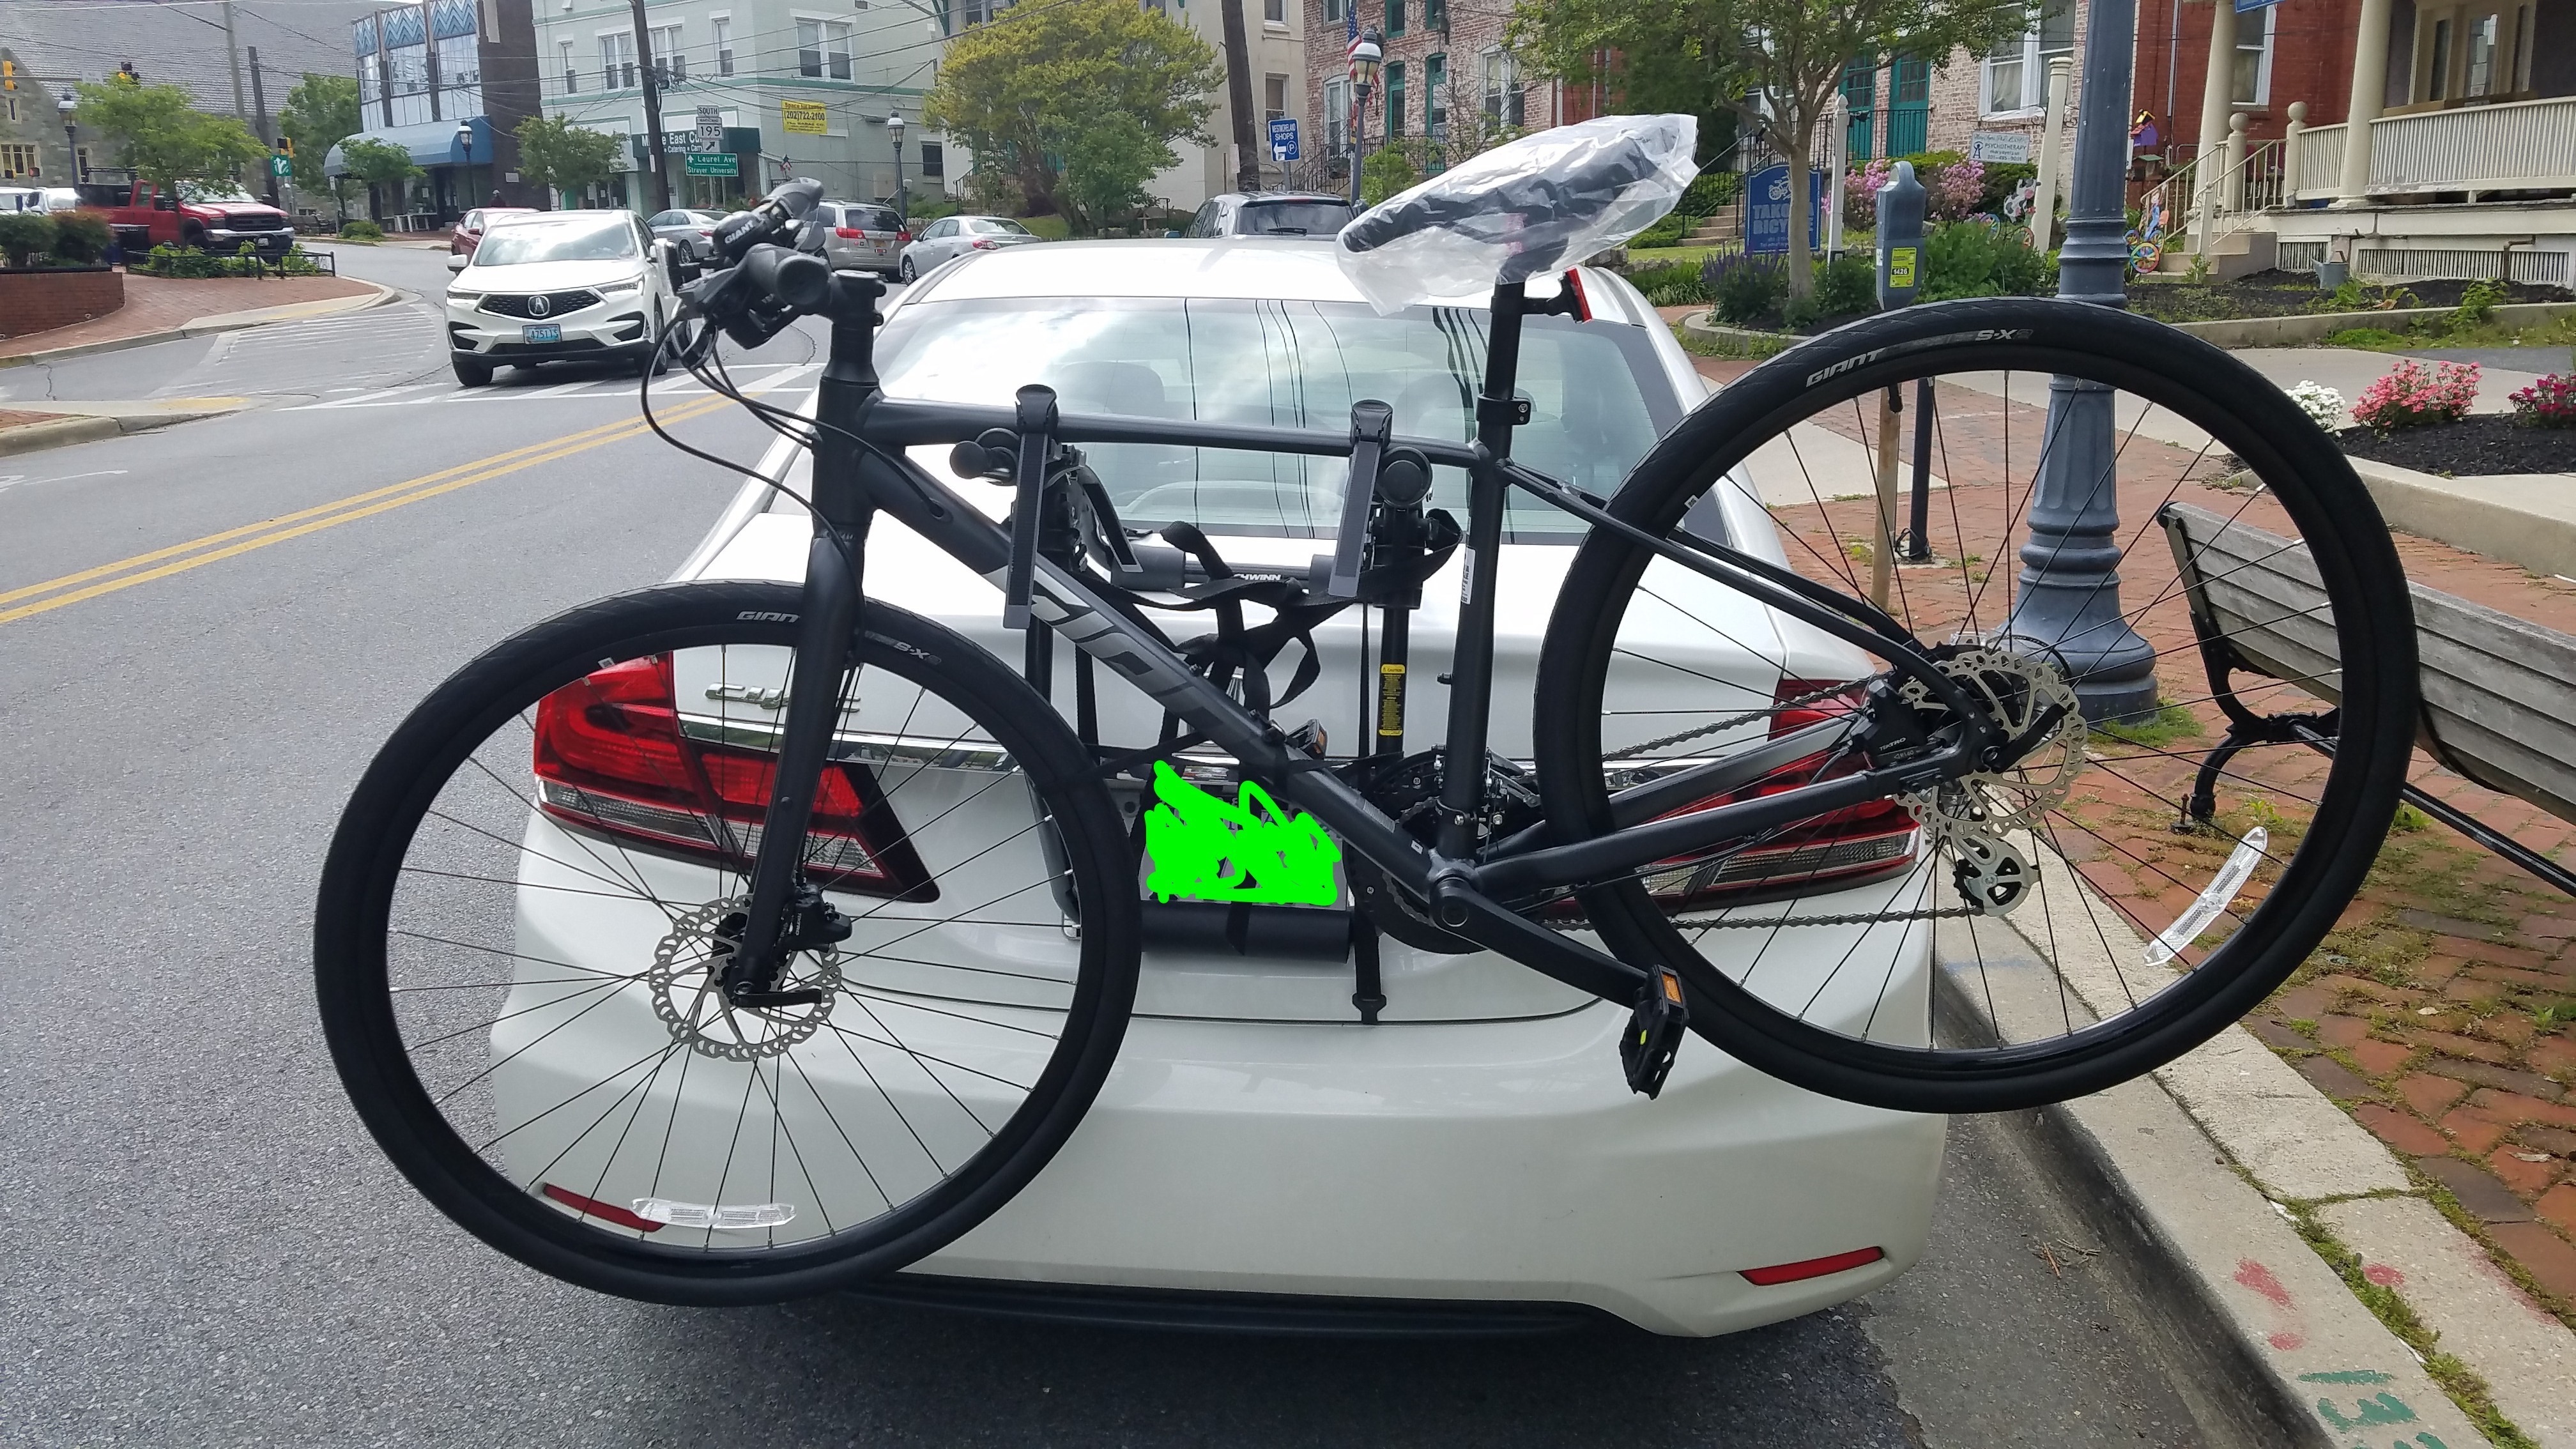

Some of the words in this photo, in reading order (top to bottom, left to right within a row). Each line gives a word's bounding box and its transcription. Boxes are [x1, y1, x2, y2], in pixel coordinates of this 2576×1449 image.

[698, 107, 718, 115] SOUTH
[669, 132, 686, 144] East
[700, 126, 721, 137] 195
[1275, 132, 1294, 141] SHOPS
[668, 145, 686, 153] Catering
[687, 166, 708, 174] Strayer
[710, 167, 737, 175] University
[1752, 202, 1814, 219] TAKOA
[724, 220, 755, 244] GIANT
[1753, 217, 1814, 234] BICYE
[1805, 347, 1887, 388] GIANT
[736, 610, 800, 624] GIAN
[1879, 737, 1906, 751] TEKTRO
